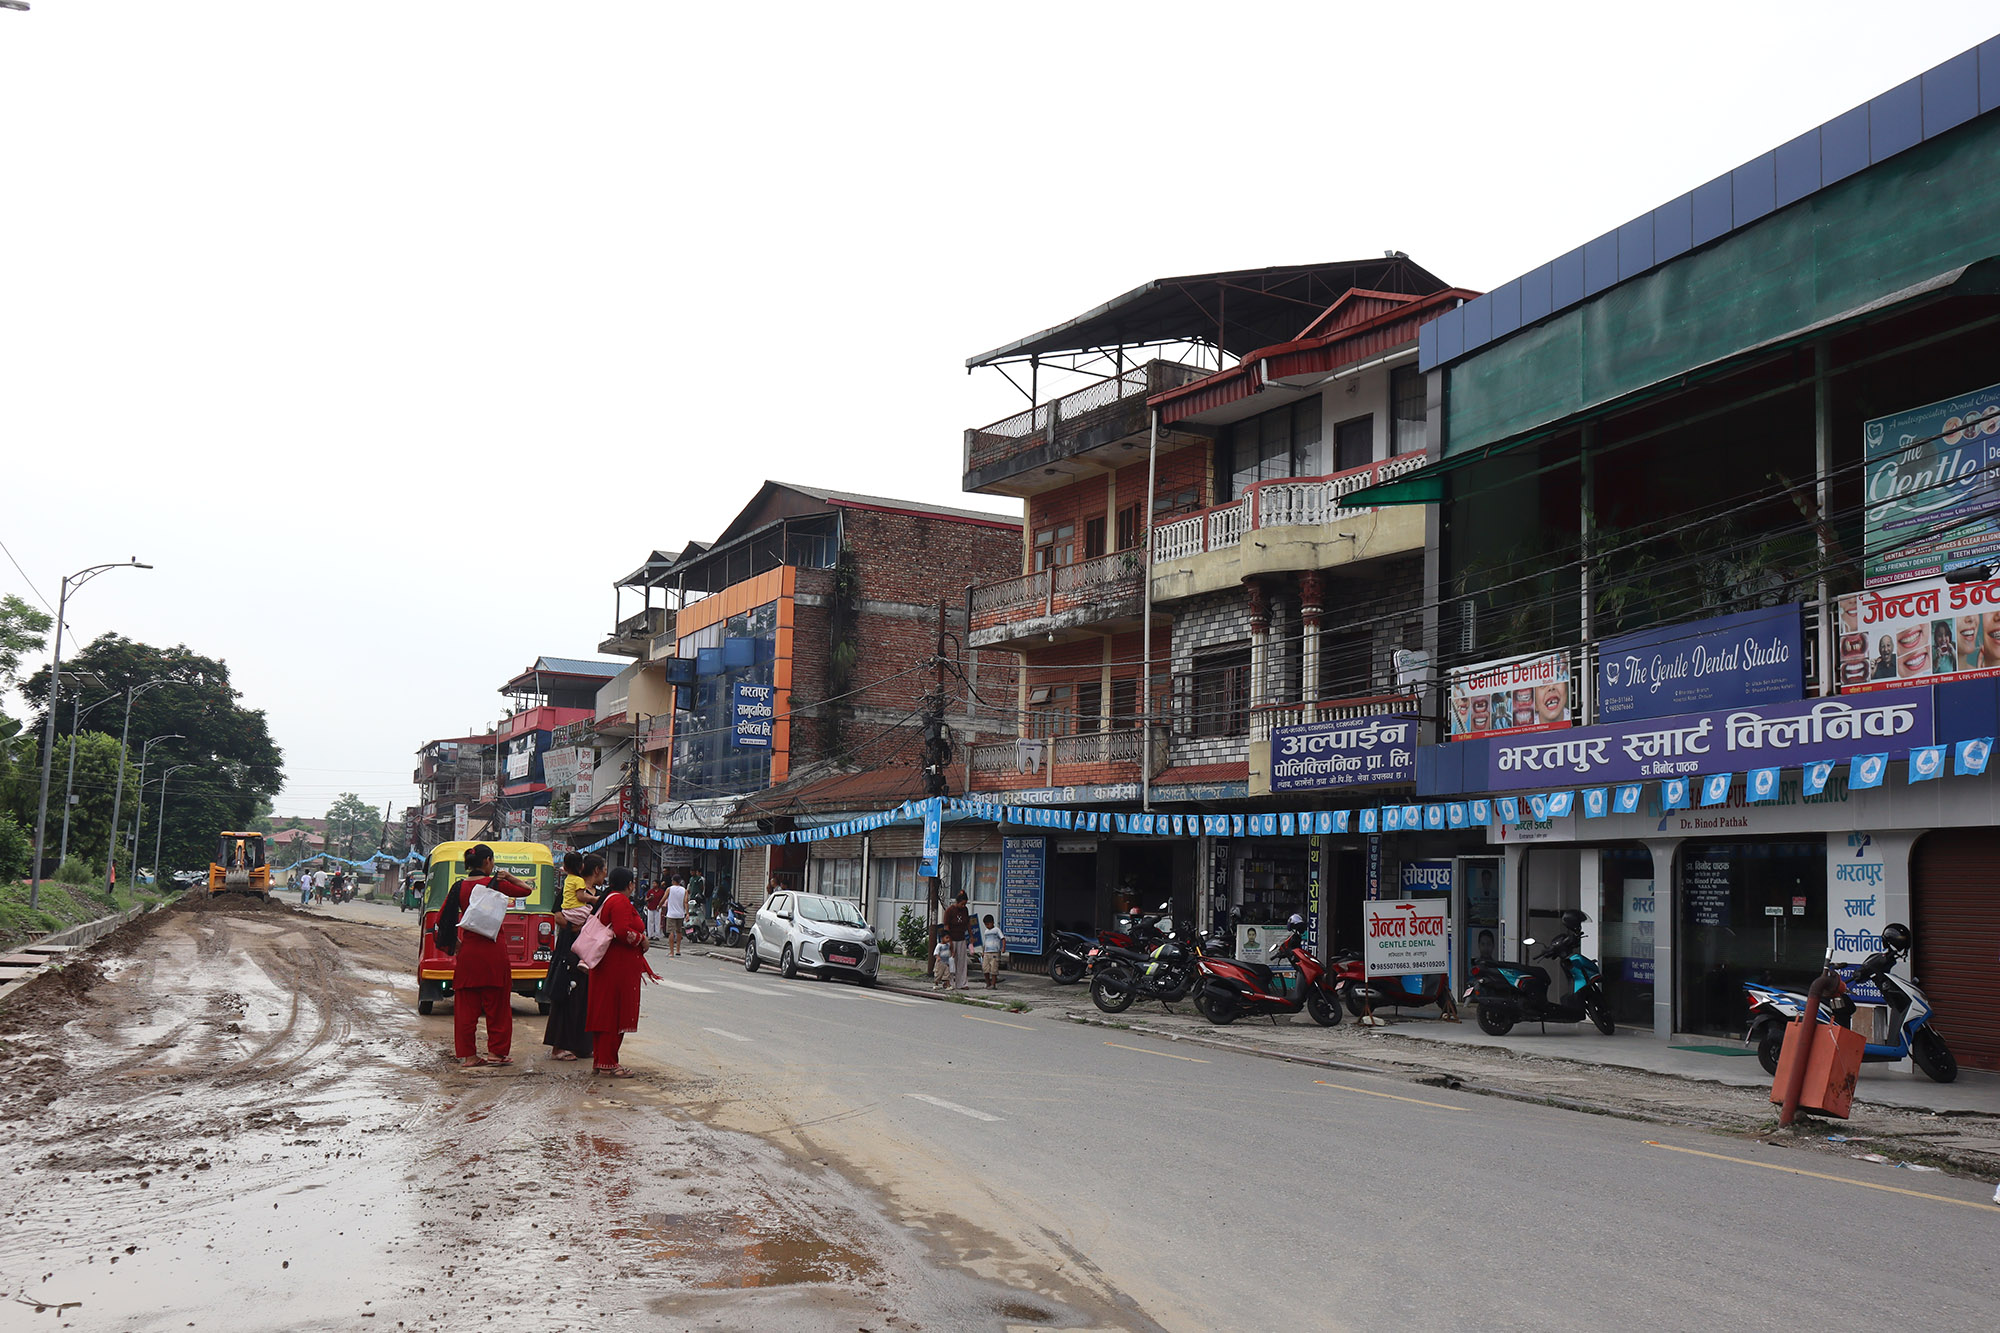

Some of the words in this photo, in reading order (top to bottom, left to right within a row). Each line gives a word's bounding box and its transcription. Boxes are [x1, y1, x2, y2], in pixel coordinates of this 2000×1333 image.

[1948, 401, 1974, 412] Dental
[1898, 434, 1923, 465] The
[1868, 449, 1977, 521] Gentle
[1963, 537, 1981, 545] CLEAR
[1953, 550, 1971, 558] TEETH
[1875, 565, 1887, 573] KIDS
[1888, 560, 1912, 570] FRIENDLY
[1913, 555, 1942, 566] DENTISTRY
[1894, 572, 1913, 581] DENTAL
[1914, 567, 1940, 577] SERVICES
[1862, 588, 1941, 623] जेन्टल
[1468, 667, 1509, 690] Gentle
[1512, 656, 1554, 684] Dental
[1625, 655, 1648, 687] The
[1650, 652, 1689, 694] Gentle
[1692, 643, 1740, 678] Dental
[1743, 637, 1790, 672] Studio
[740, 686, 770, 701] भरतपुर
[737, 702, 772, 719] सामुदायिक
[1281, 721, 1409, 755] अल्पाईन
[1498, 737, 1612, 773] भरतपुर
[1622, 718, 1713, 762] स्मार्ट
[1725, 702, 1917, 751] क्लिनिक
[1274, 754, 1363, 777] पोलिक्लिनिक
[1366, 754, 1385, 771] प्रा.
[1390, 748, 1413, 768] लि.
[1641, 764, 1651, 776] डा.
[1653, 760, 1674, 775] विनोद
[1676, 760, 1699, 773] पाठक
[1357, 772, 1369, 782] सेवा
[1002, 790, 1054, 805] अस्पताल
[1094, 784, 1138, 799] फार्मेसी
[1680, 818, 1693, 829] Dr.
[1695, 817, 1718, 829] Binod
[1719, 815, 1748, 828] Pathak
[1006, 840, 1020, 849] आशा
[1021, 839, 1043, 849] अस्पताल
[1402, 863, 1451, 890] सोधपुछ
[1836, 863, 1883, 886] भरतपुर
[1844, 894, 1876, 918] स्मार्ट
[1369, 911, 1407, 938] जेन्टल
[1409, 910, 1444, 936] डेन्टल
[1379, 941, 1407, 949] GENTLE
[1413, 960, 1446, 968] 9845109205
